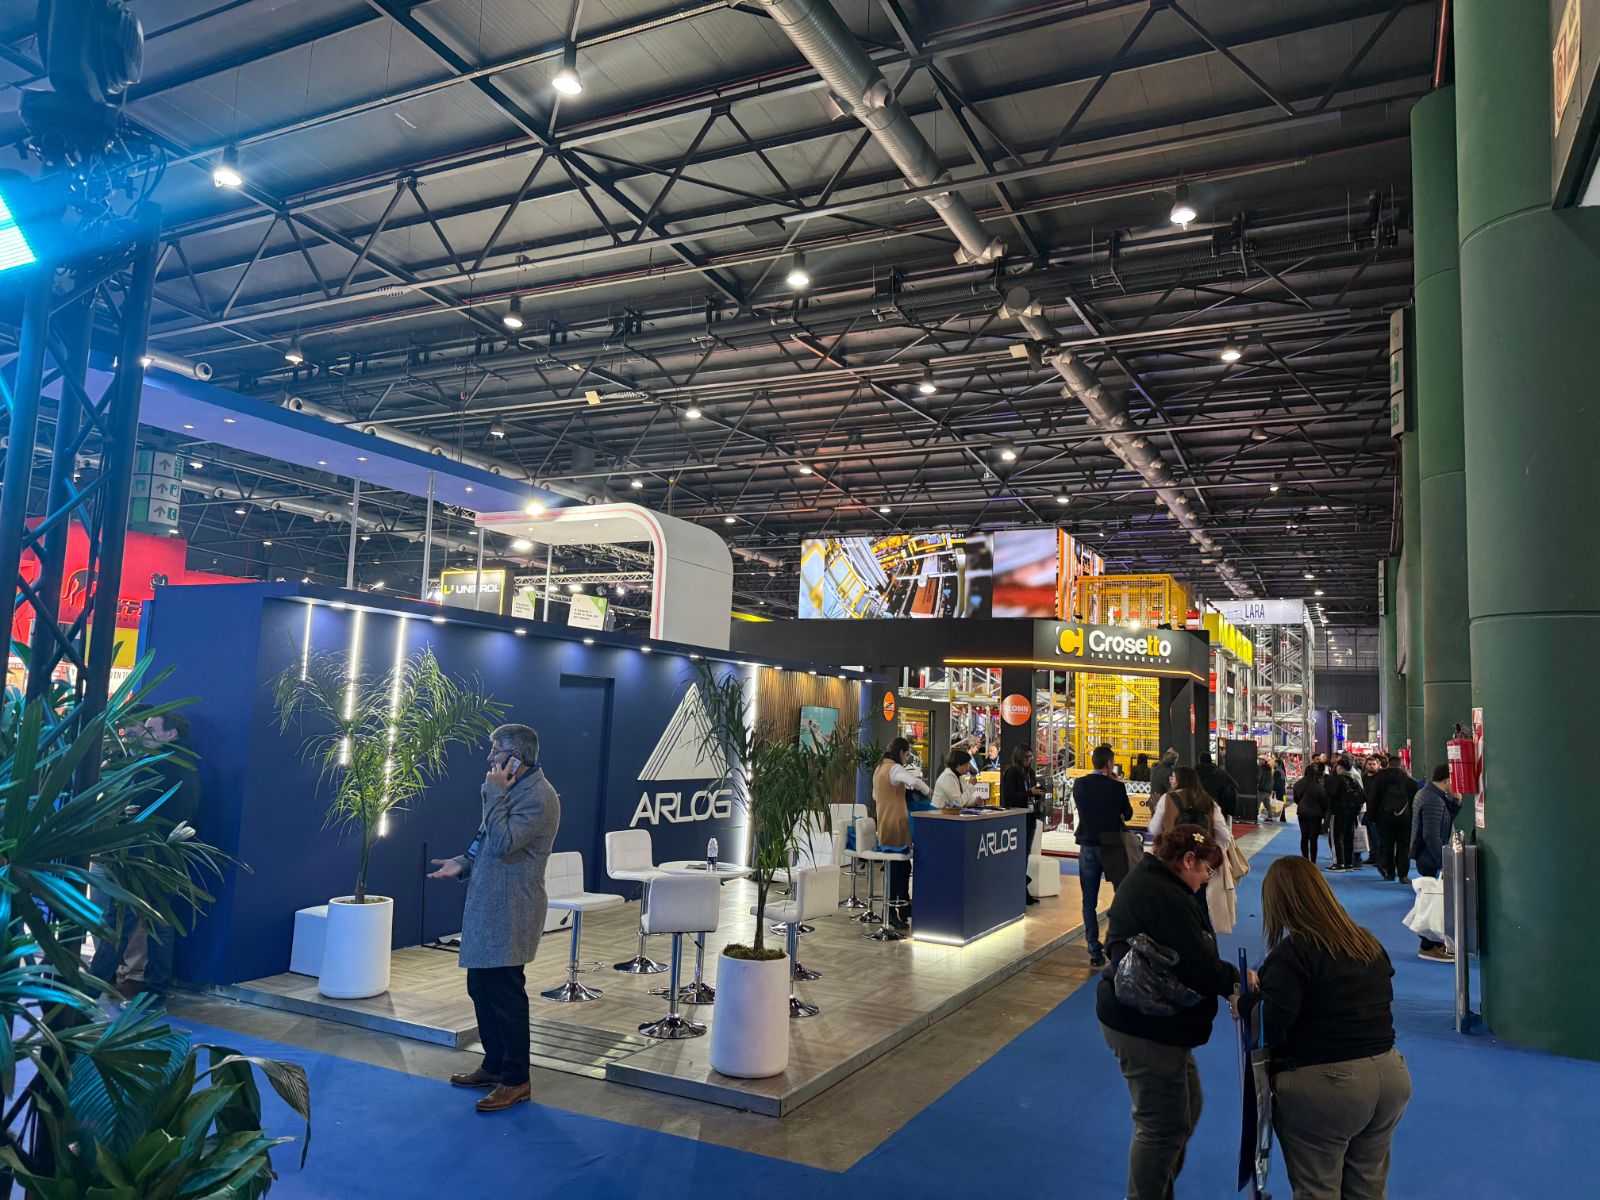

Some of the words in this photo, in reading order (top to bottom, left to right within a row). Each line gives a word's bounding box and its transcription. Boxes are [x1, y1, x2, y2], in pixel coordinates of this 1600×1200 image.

[1245, 603, 1265, 619] LARA
[1088, 630, 1172, 657] Crosetto
[629, 788, 733, 828] ARLOG
[976, 827, 1018, 860] ARLOG
